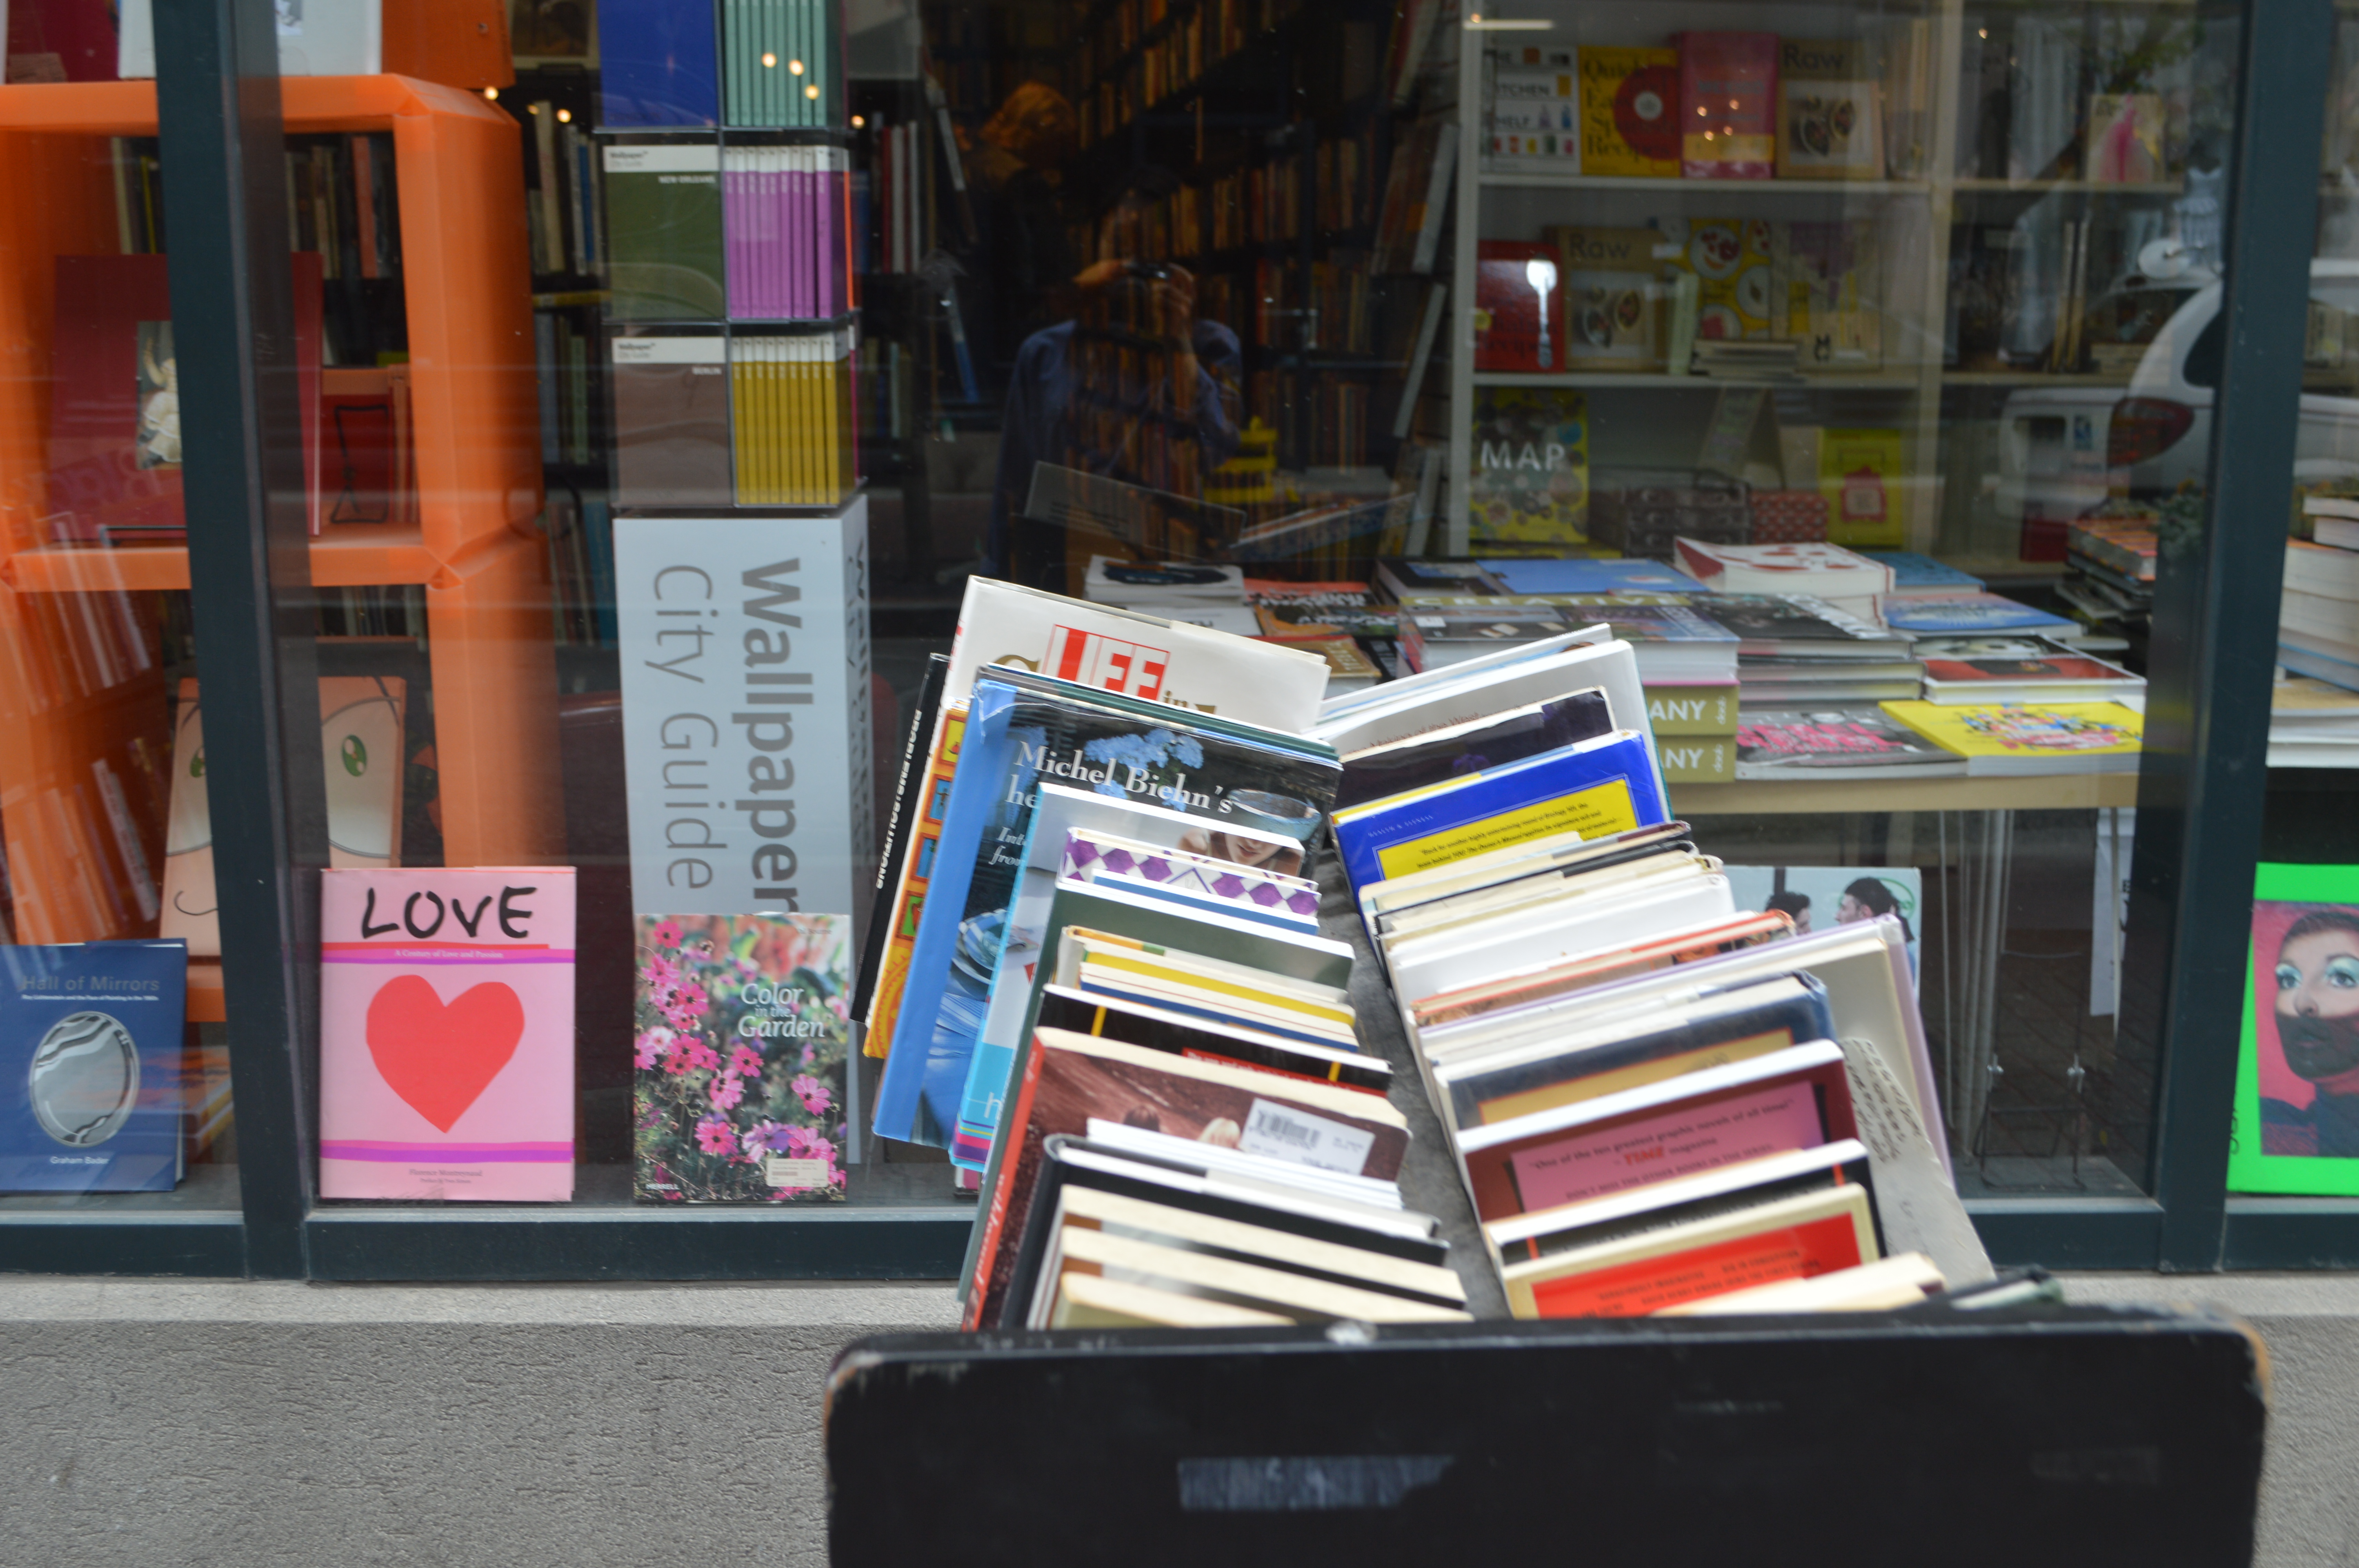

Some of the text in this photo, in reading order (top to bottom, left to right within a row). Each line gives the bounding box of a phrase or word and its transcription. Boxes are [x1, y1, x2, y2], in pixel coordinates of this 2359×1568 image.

[1784, 44, 1844, 70] Raw
[1493, 83, 1550, 96] ITCHEN
[1569, 235, 1630, 259] Raw
[1480, 440, 1566, 470] MAP
[644, 565, 727, 888] City Guide
[731, 557, 813, 914] Wallpaper
[1663, 748, 1705, 769] NY
[1014, 741, 1233, 814] Michel Biehn's
[361, 885, 538, 939] LOVE
[24, 976, 160, 991] Hall of Mirrors
[741, 982, 805, 1004] Color
[755, 1004, 791, 1017] in the
[738, 1014, 825, 1037] Garden
[50, 1156, 82, 1164] Graham
